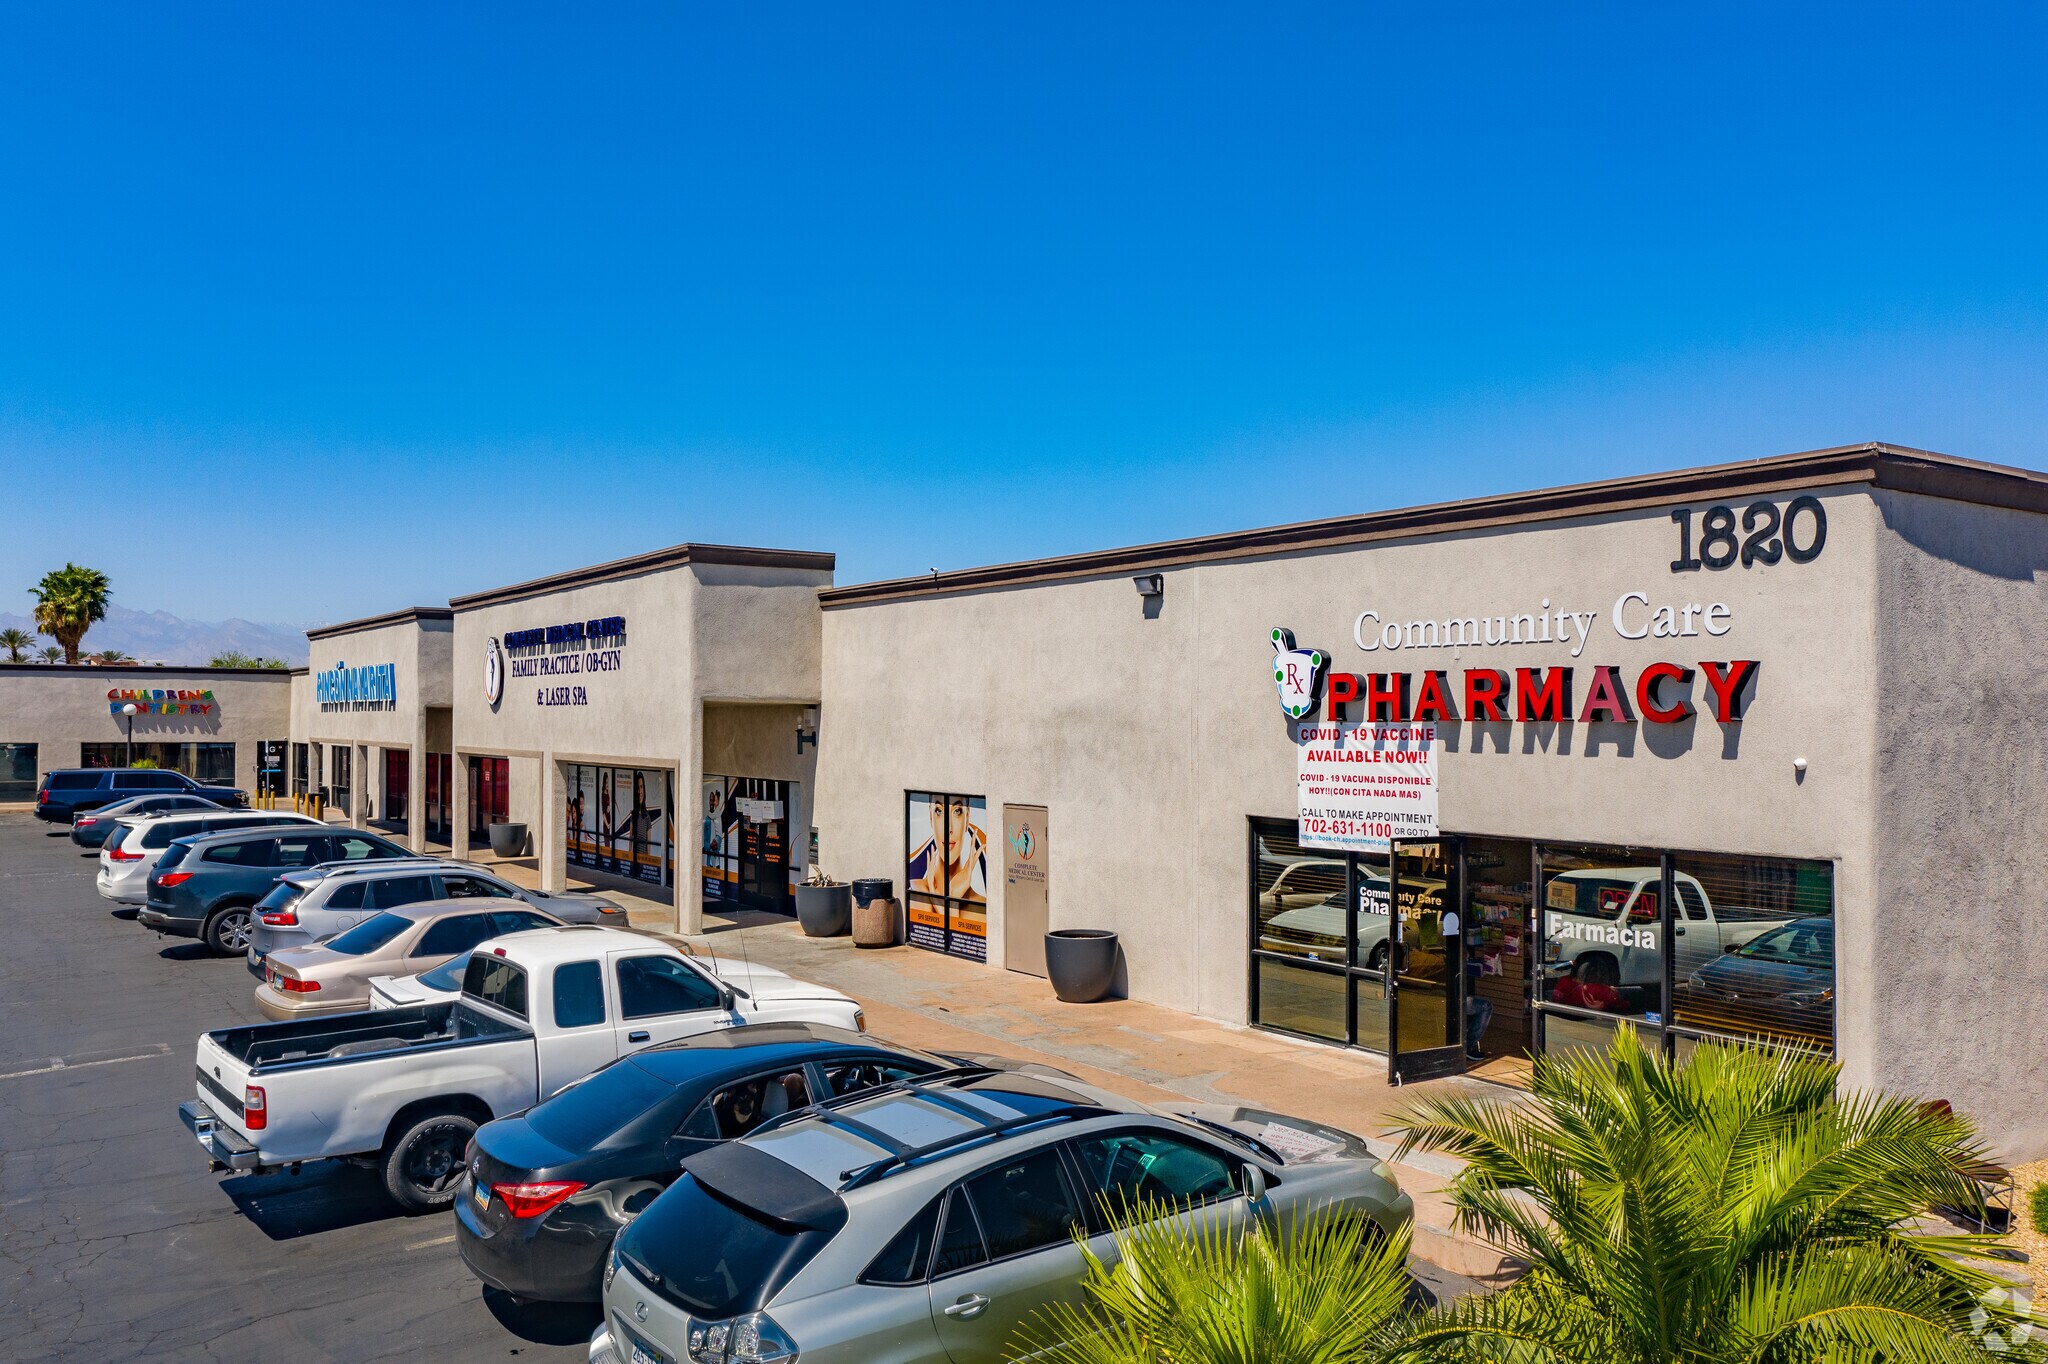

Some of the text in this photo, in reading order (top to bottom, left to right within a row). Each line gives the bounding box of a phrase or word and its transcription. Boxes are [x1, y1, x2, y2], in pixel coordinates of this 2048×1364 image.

[1671, 496, 1828, 573] 1820
[1353, 591, 1731, 657] Community Care
[512, 659, 539, 677] FAMILY
[540, 654, 580, 675] PRACTICE
[586, 650, 621, 673] OB-GYN
[107, 688, 213, 700] CHILDREN'S
[537, 686, 588, 706] & LASER SPA
[1327, 660, 1759, 724] PHARMACY
[110, 703, 213, 715] DNTISTRY
[1300, 728, 1341, 740] COVID
[1352, 729, 1367, 741] 19
[1371, 728, 1435, 741] VACCINE
[1307, 750, 1428, 764] AVAILABLE NOW!!
[1300, 773, 1325, 782] COVID
[1331, 774, 1340, 782] 19
[1341, 775, 1376, 784] VACUNA
[1378, 776, 1432, 786] DISPONIBLE
[1352, 788, 1372, 797] CITA
[1373, 789, 1397, 798] NADA
[1399, 790, 1422, 800] MAS)
[1301, 808, 1433, 824] CALL TO MAKE APPOINTMENT
[1304, 818, 1429, 838] 702-631-1100 OR GO TO
[1417, 893, 1442, 906] Care
[925, 914, 940, 924] SERVICES
[965, 923, 982, 932] SERVICES
[1549, 913, 1656, 950] Farmacia
